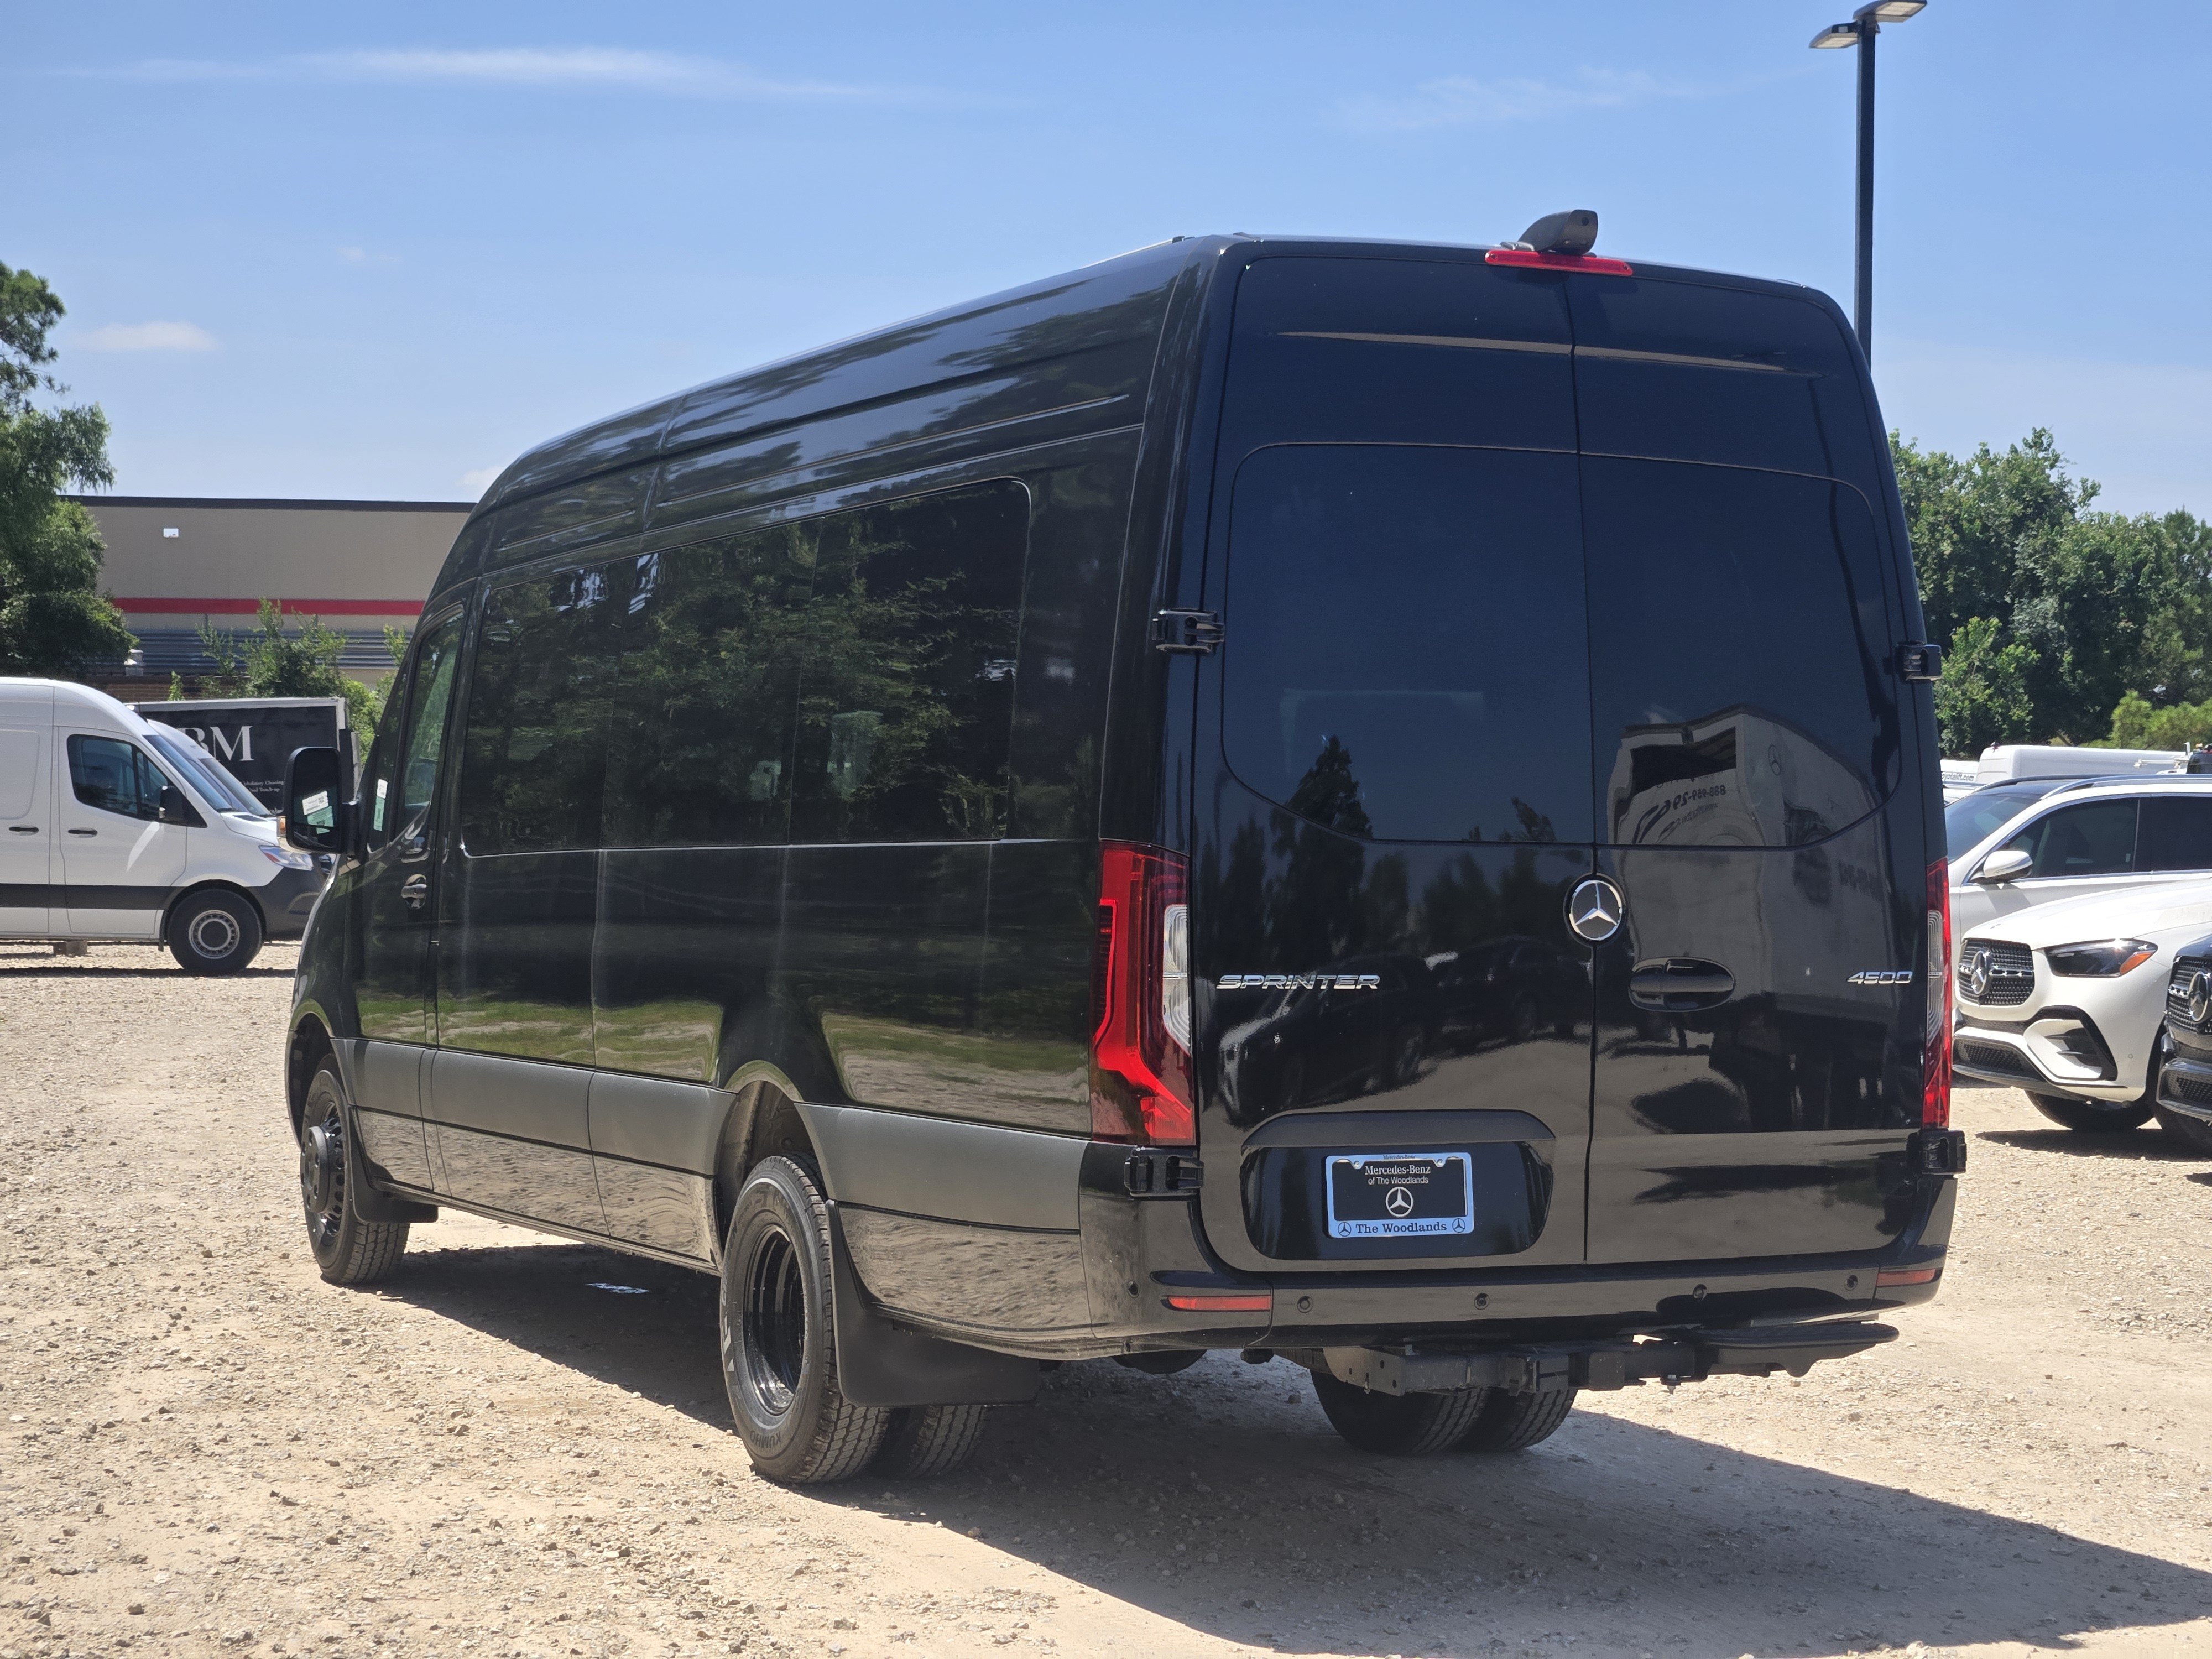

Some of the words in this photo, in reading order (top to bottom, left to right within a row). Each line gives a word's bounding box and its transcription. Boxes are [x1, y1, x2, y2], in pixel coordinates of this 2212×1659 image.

[1217, 975, 1380, 989] SPRINTER
[1847, 971, 1913, 984] 4500
[1365, 1165, 1431, 1175] Mercedes-Benz
[1368, 1177, 1375, 1185] of
[1391, 1176, 1429, 1184] Woodlands
[1355, 1224, 1378, 1233] The
[1382, 1222, 1447, 1233] Woodlands
[749, 1430, 781, 1448] KUMHO
